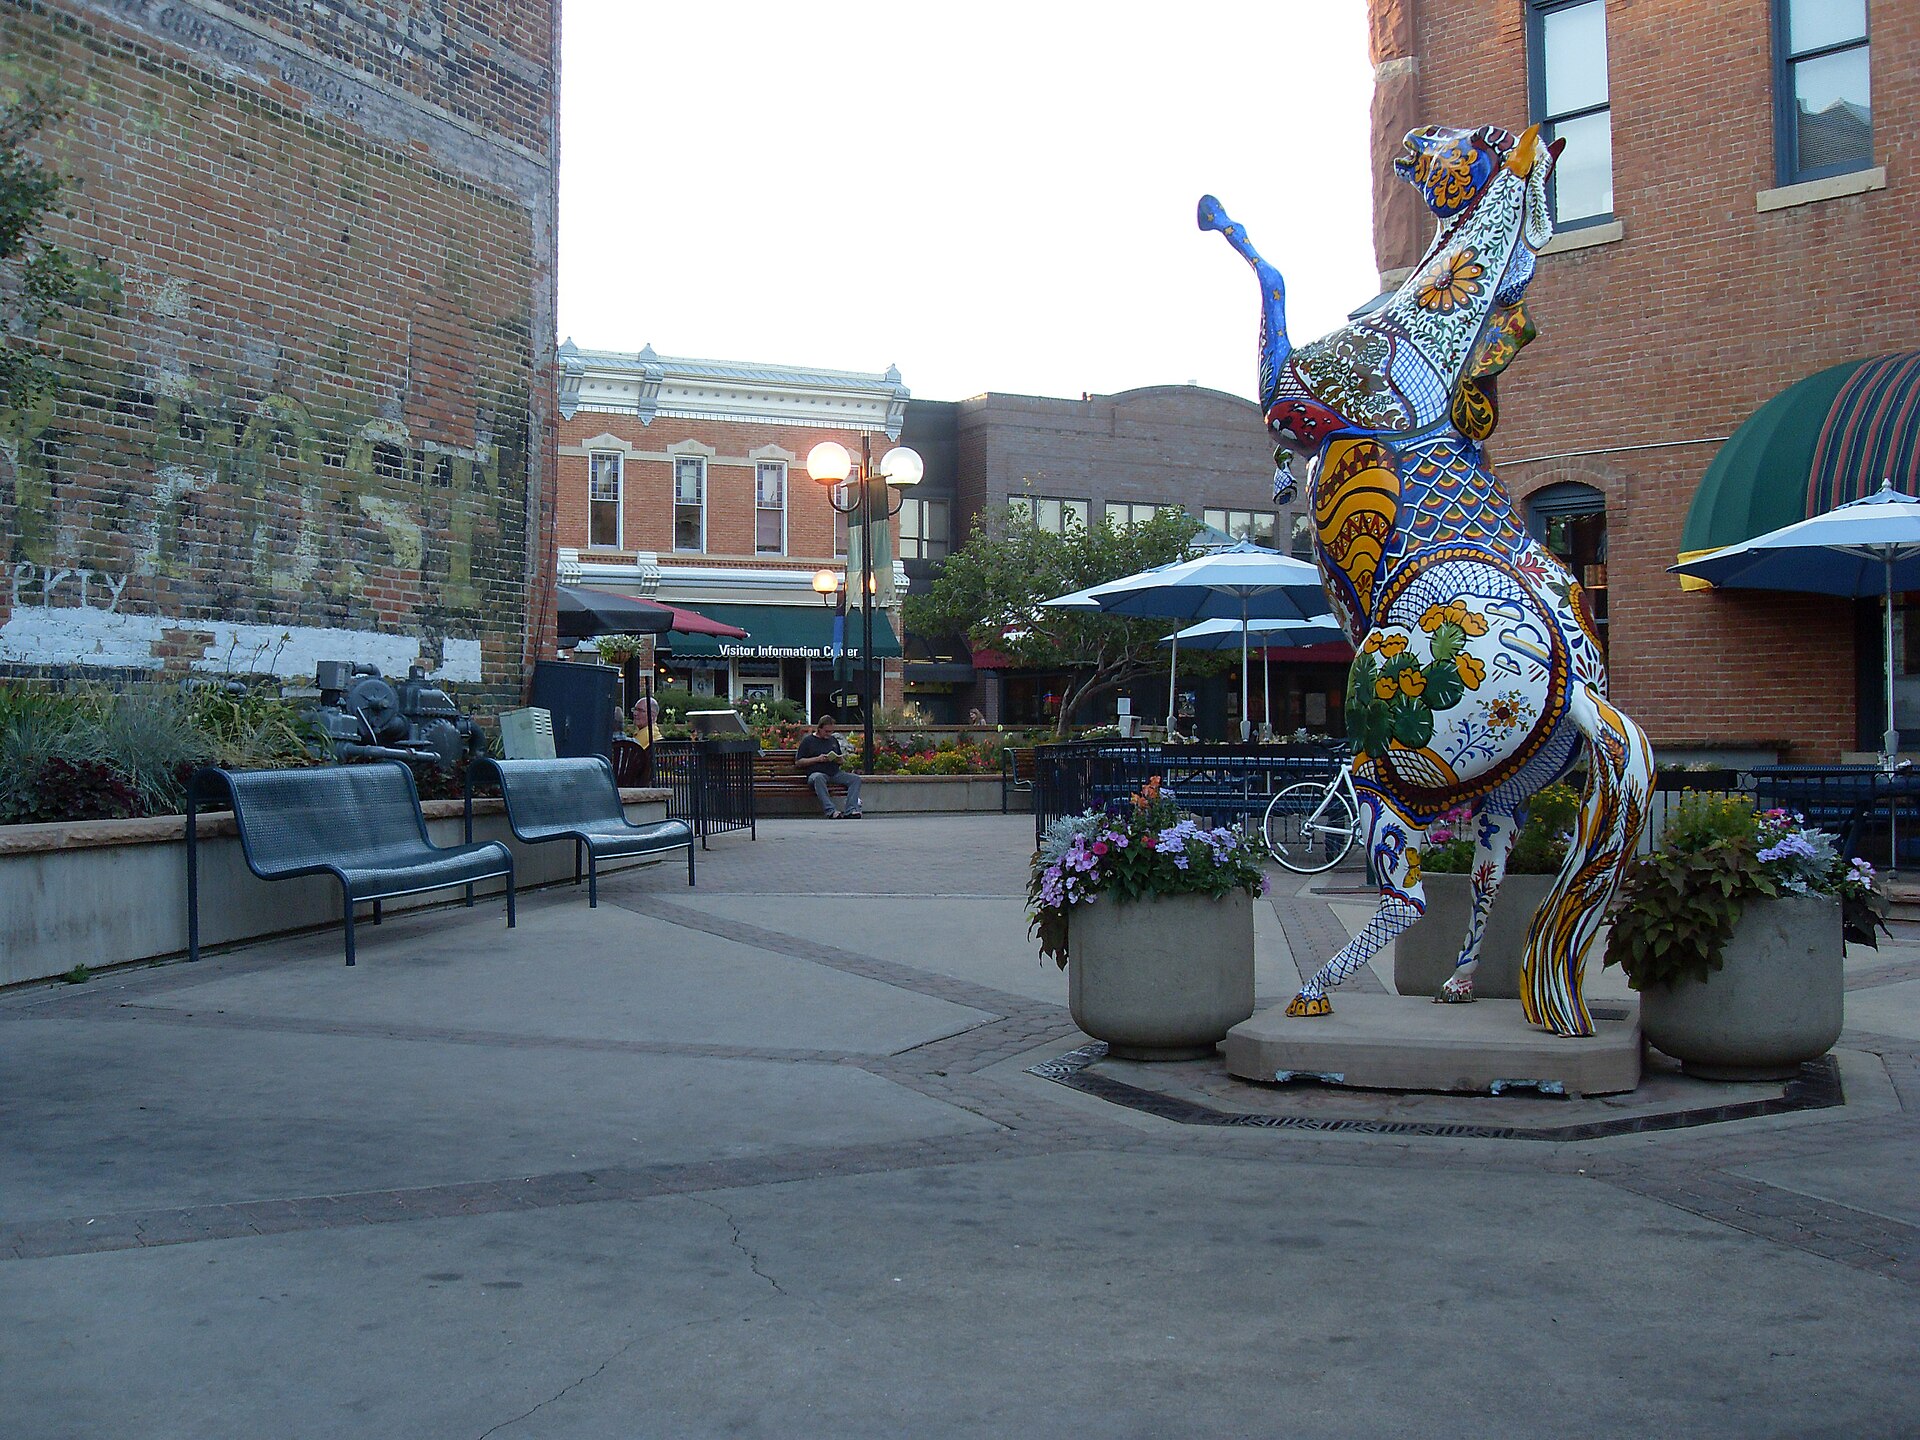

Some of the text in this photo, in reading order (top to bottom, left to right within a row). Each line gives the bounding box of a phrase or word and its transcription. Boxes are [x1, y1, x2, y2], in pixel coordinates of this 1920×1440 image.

[719, 644, 858, 657] Visitor Information Cer
